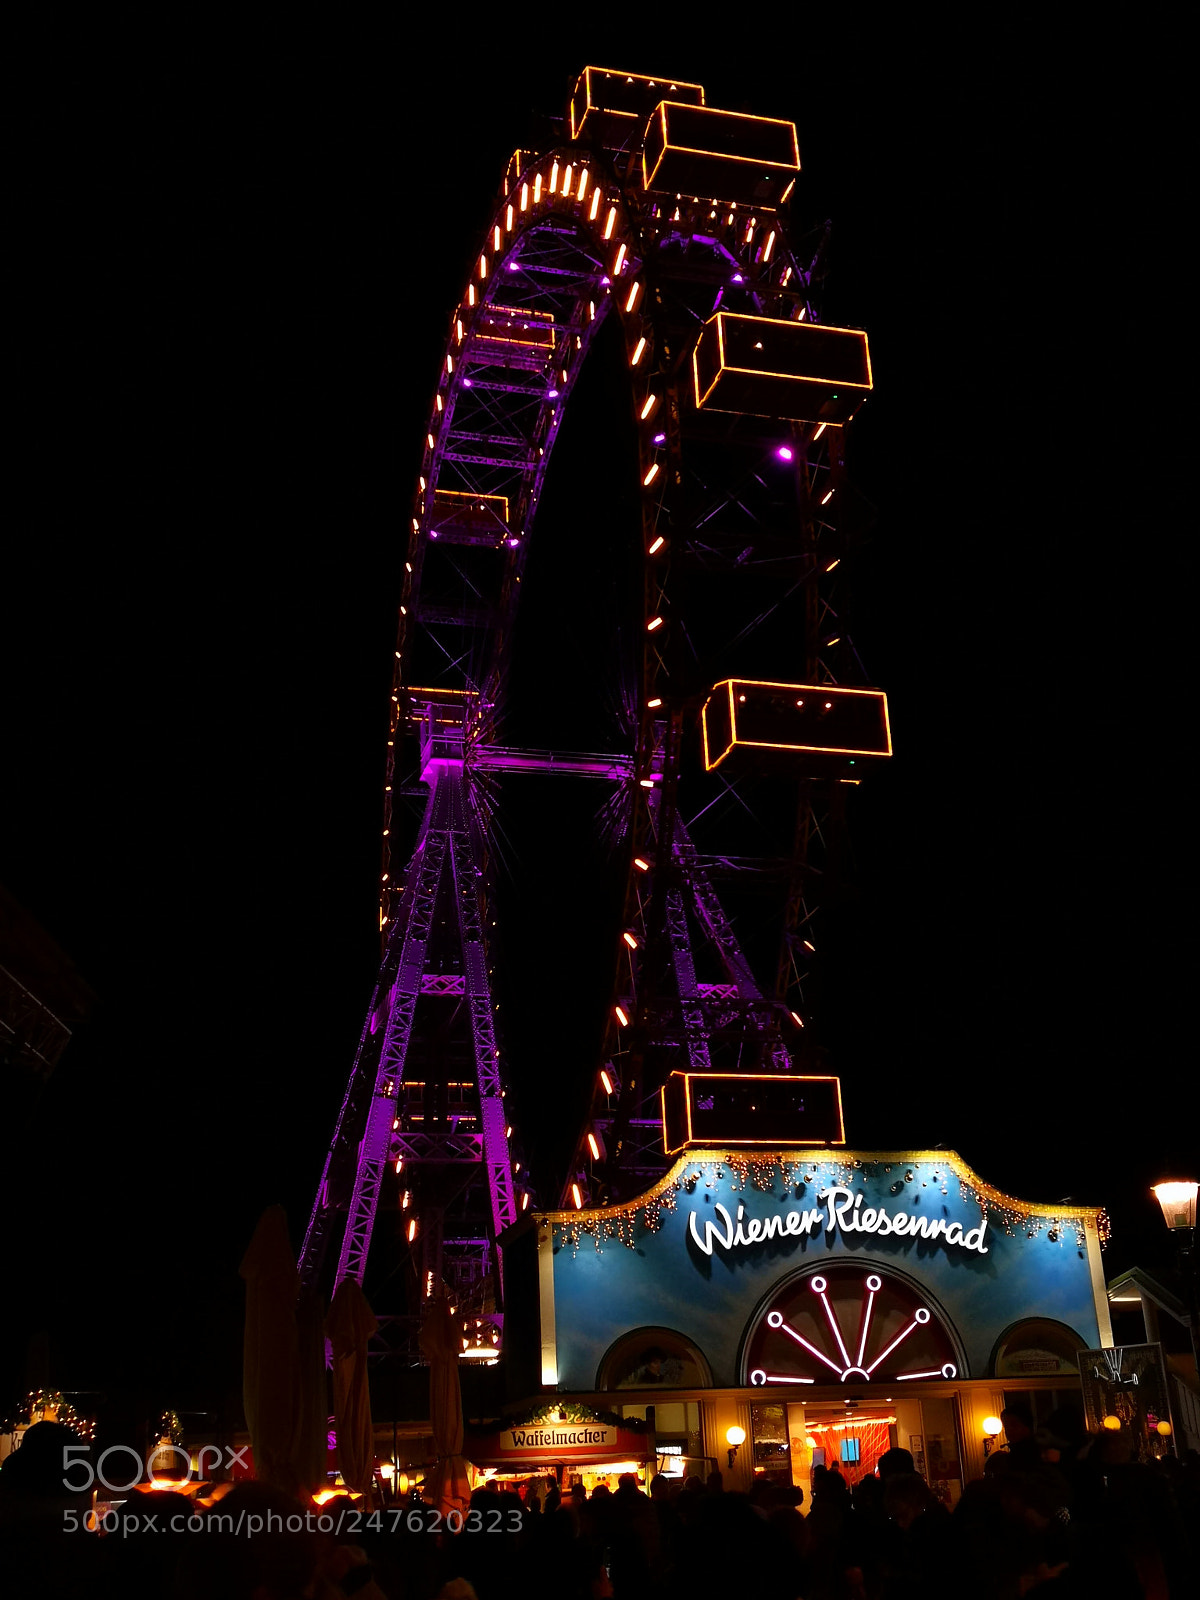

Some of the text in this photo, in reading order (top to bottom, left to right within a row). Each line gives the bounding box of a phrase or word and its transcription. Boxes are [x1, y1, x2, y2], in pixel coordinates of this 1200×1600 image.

[688, 1186, 989, 1255] Wiener Riesenrad
[511, 1428, 607, 1447] Waffelmacher
